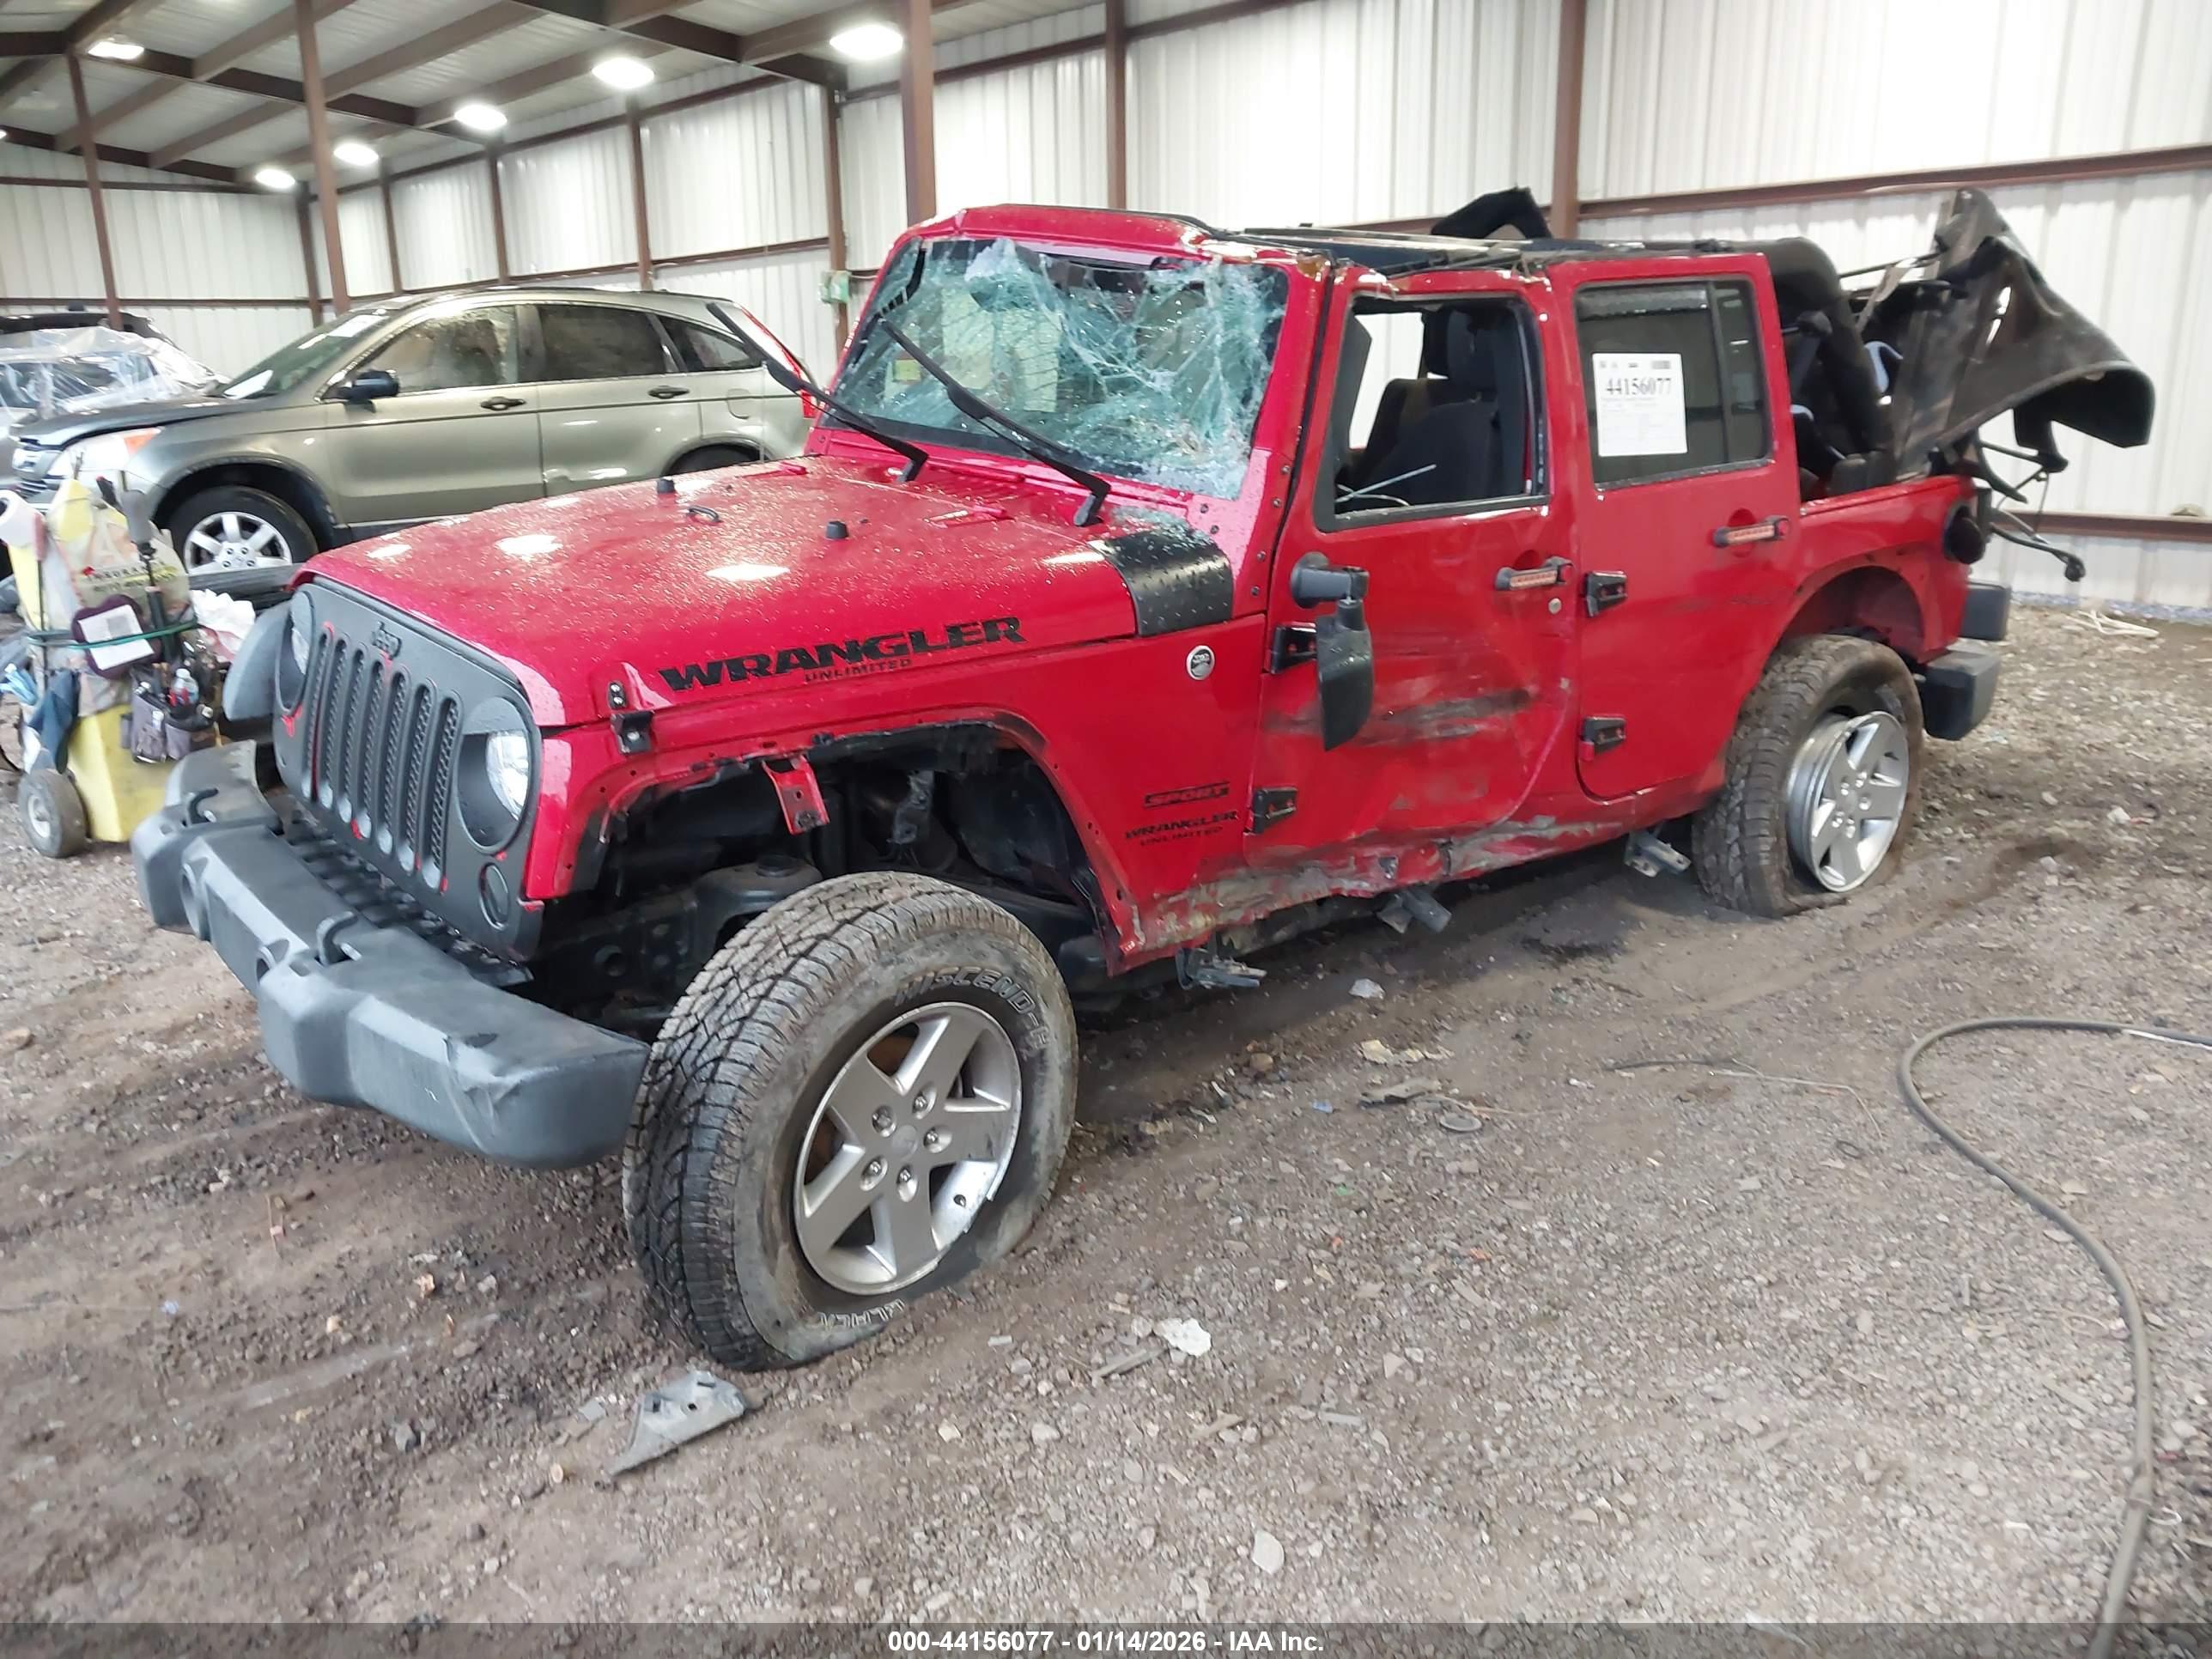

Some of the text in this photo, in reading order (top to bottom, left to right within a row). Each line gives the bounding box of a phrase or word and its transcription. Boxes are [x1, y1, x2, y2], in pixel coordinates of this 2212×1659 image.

[1605, 377, 1672, 396] 44156077
[658, 617, 1028, 691] WRANGLER
[804, 659, 912, 684] UNLIMITED
